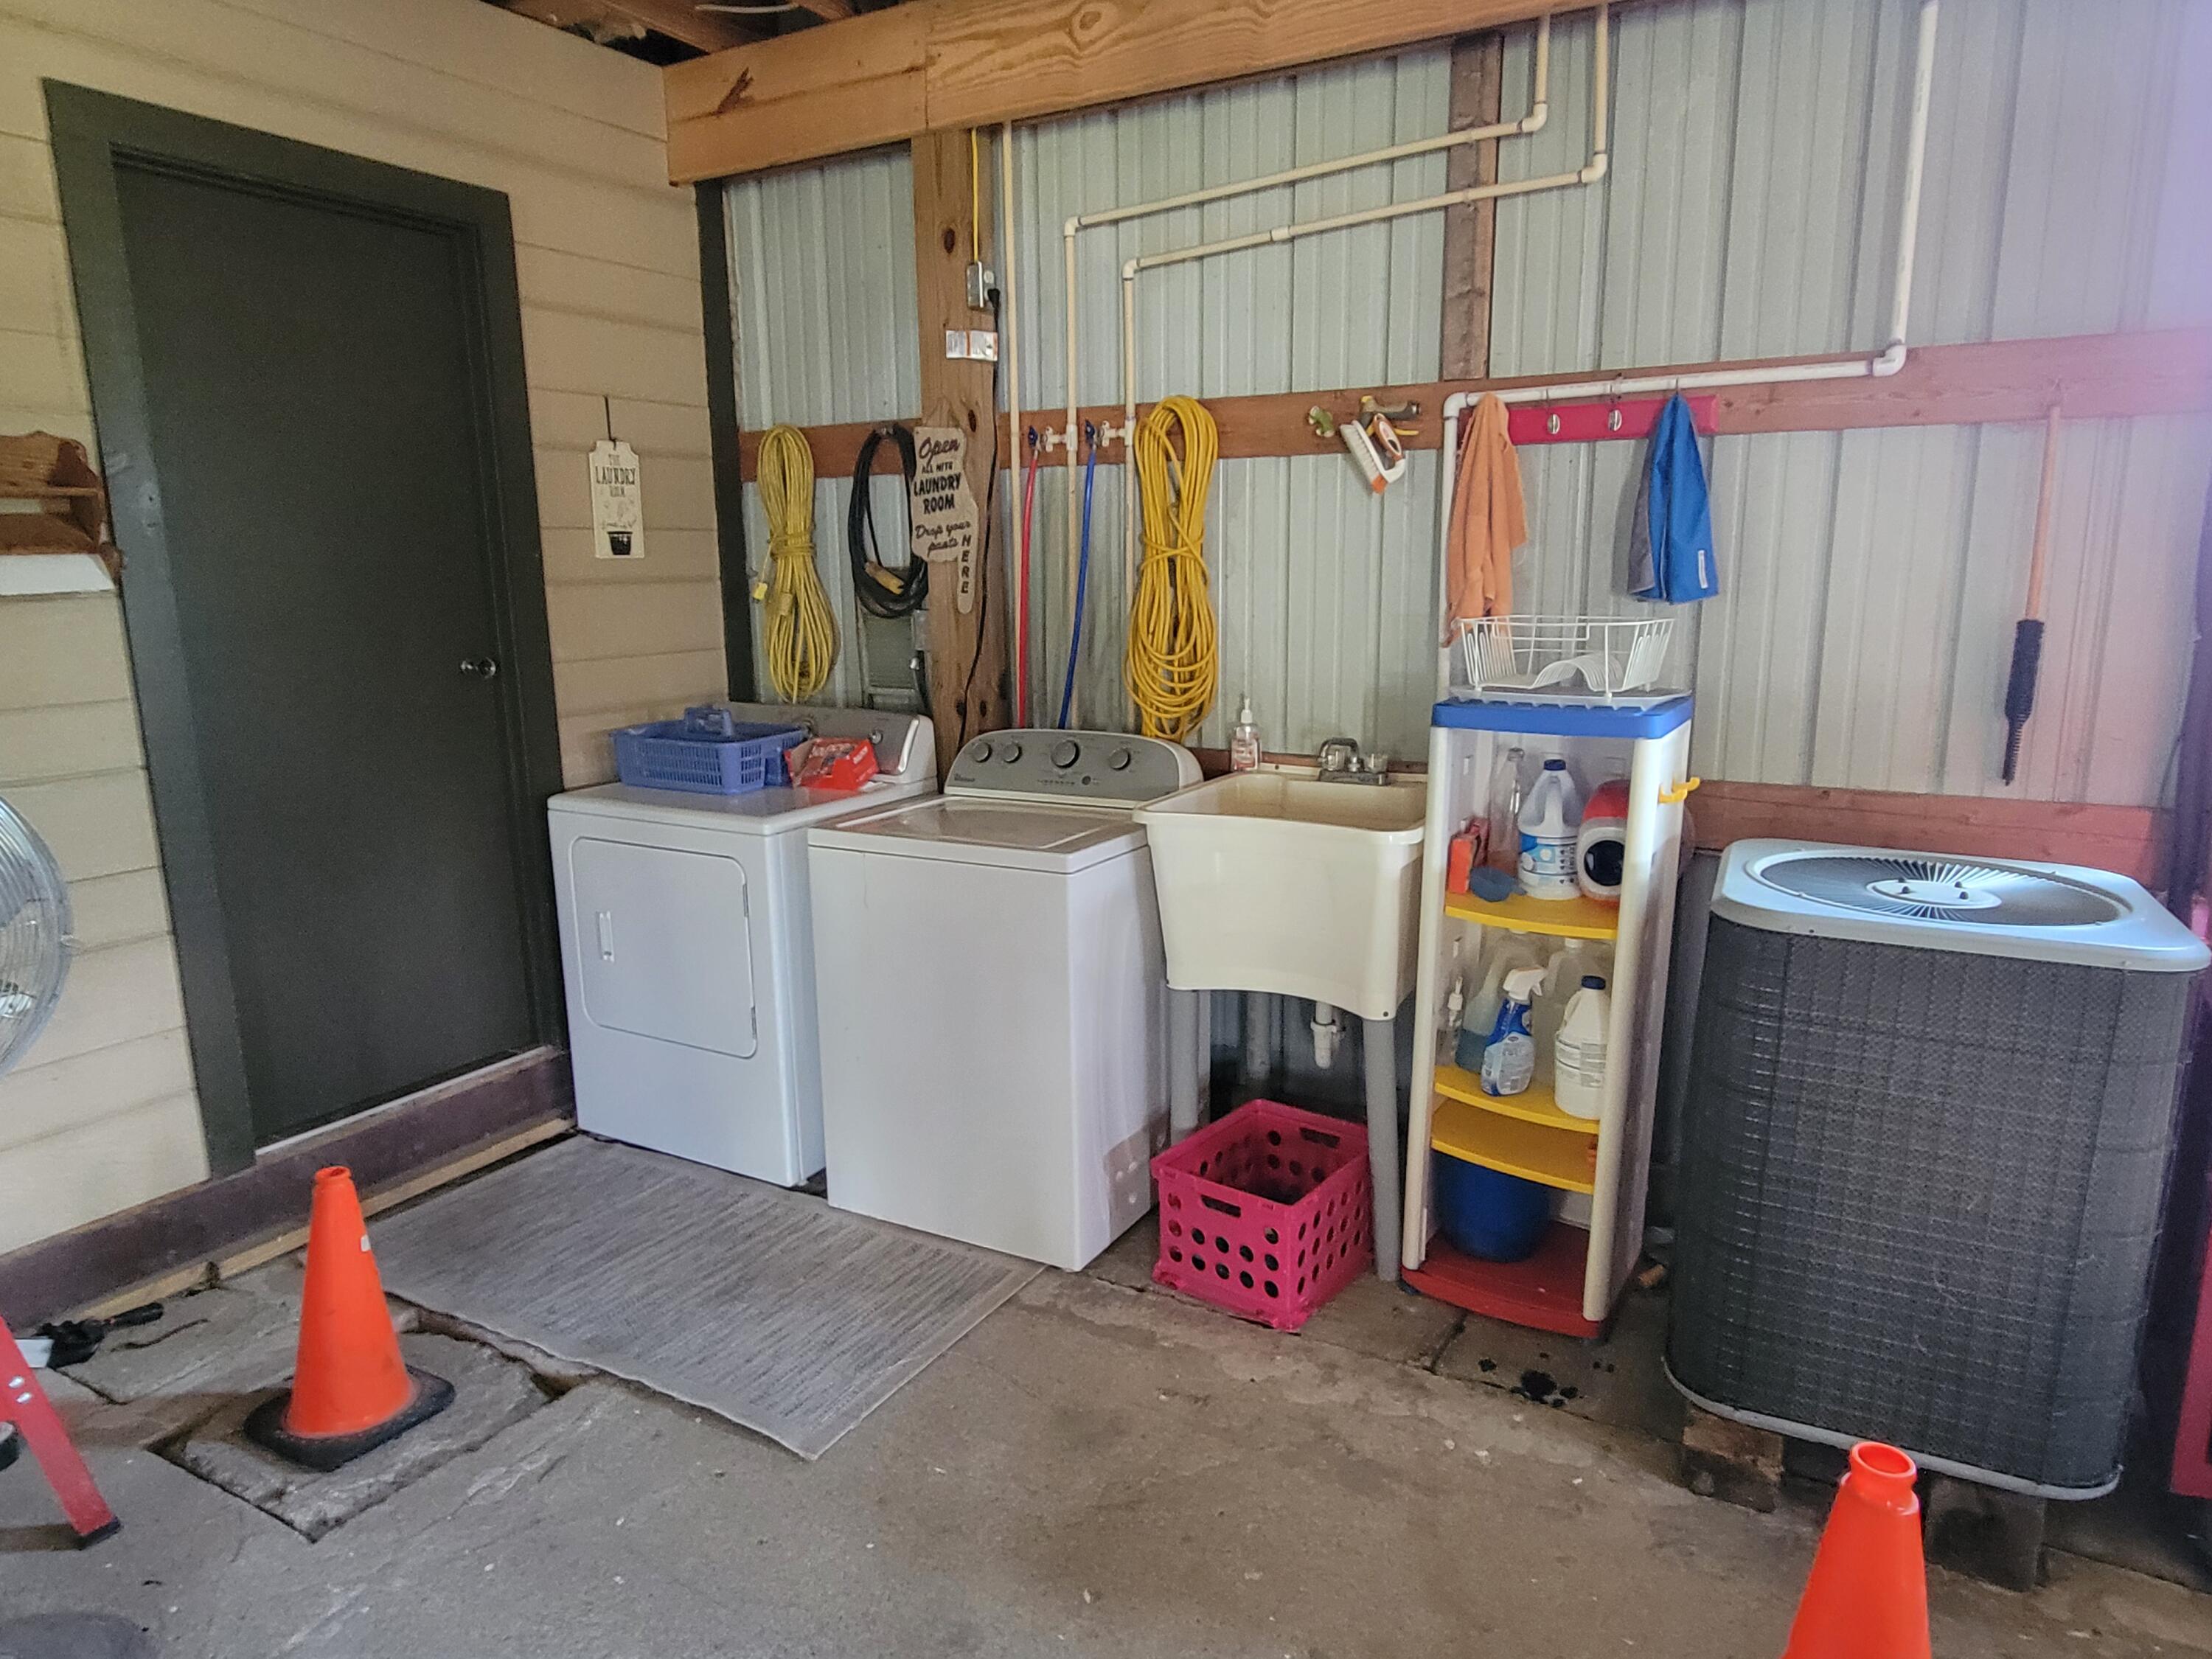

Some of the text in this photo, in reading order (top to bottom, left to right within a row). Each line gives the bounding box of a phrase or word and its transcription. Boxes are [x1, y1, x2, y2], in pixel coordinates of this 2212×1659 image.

[919, 437, 960, 469] Open
[595, 465, 636, 485] LAUNDRY
[914, 472, 961, 497] LAUNDRY
[923, 493, 955, 515] ROOM
[915, 524, 944, 540] Drop
